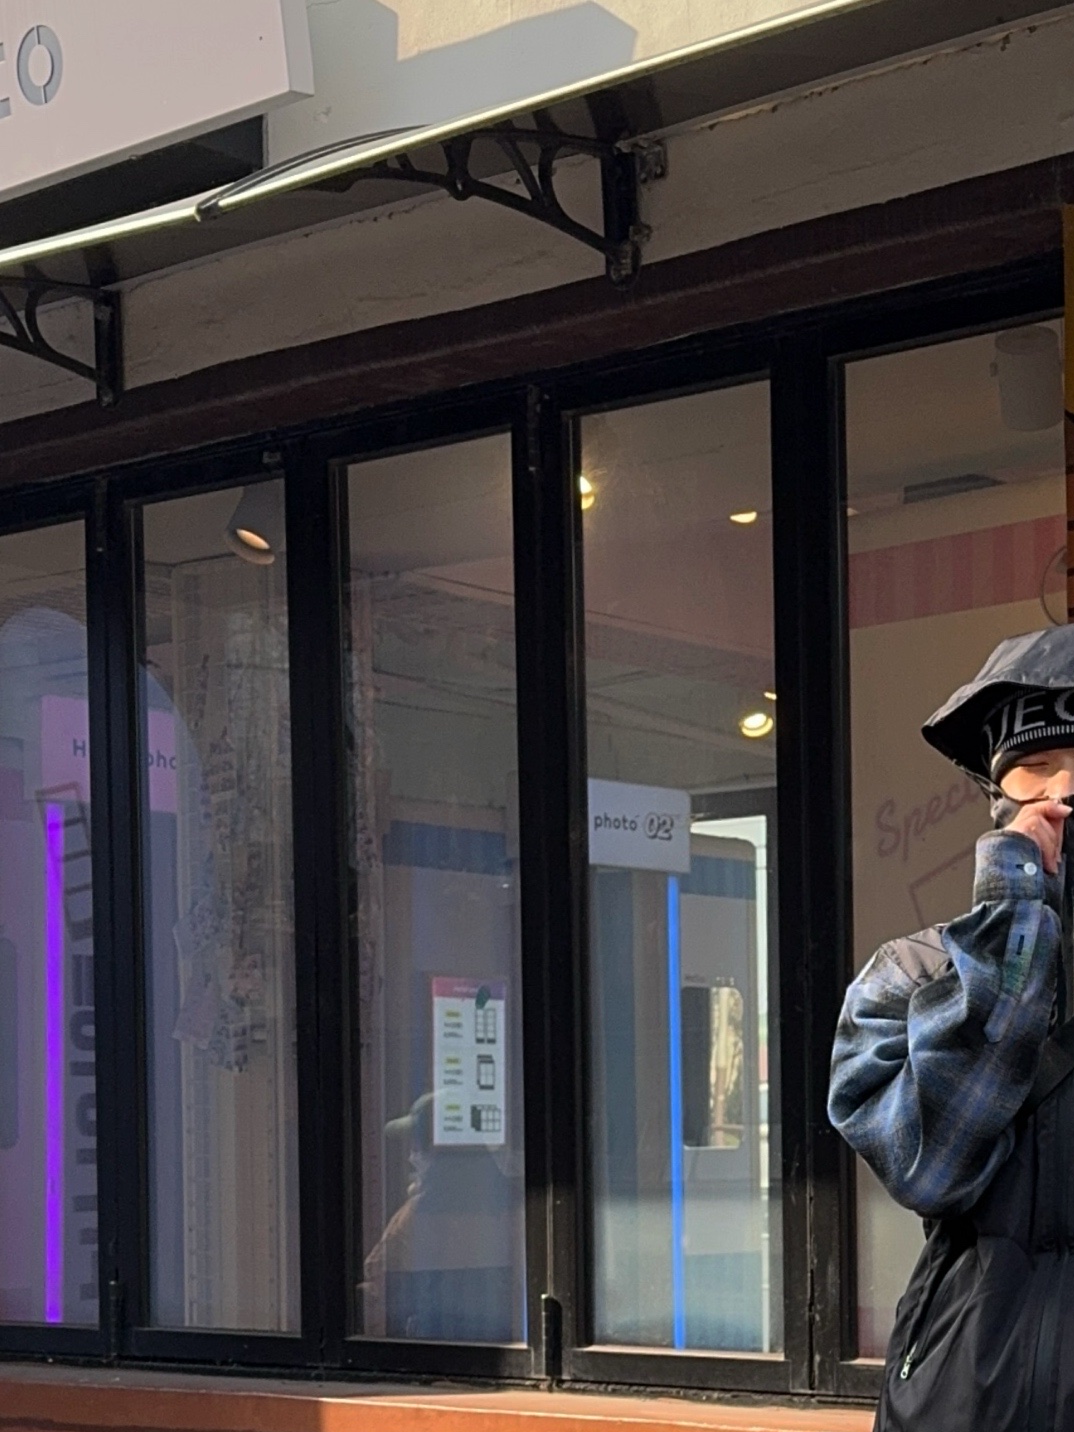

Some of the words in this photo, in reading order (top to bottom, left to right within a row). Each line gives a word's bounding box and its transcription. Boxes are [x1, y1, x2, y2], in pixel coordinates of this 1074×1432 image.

[0, 25, 63, 118] O
[594, 812, 638, 831] photo
[645, 813, 675, 841] 02
